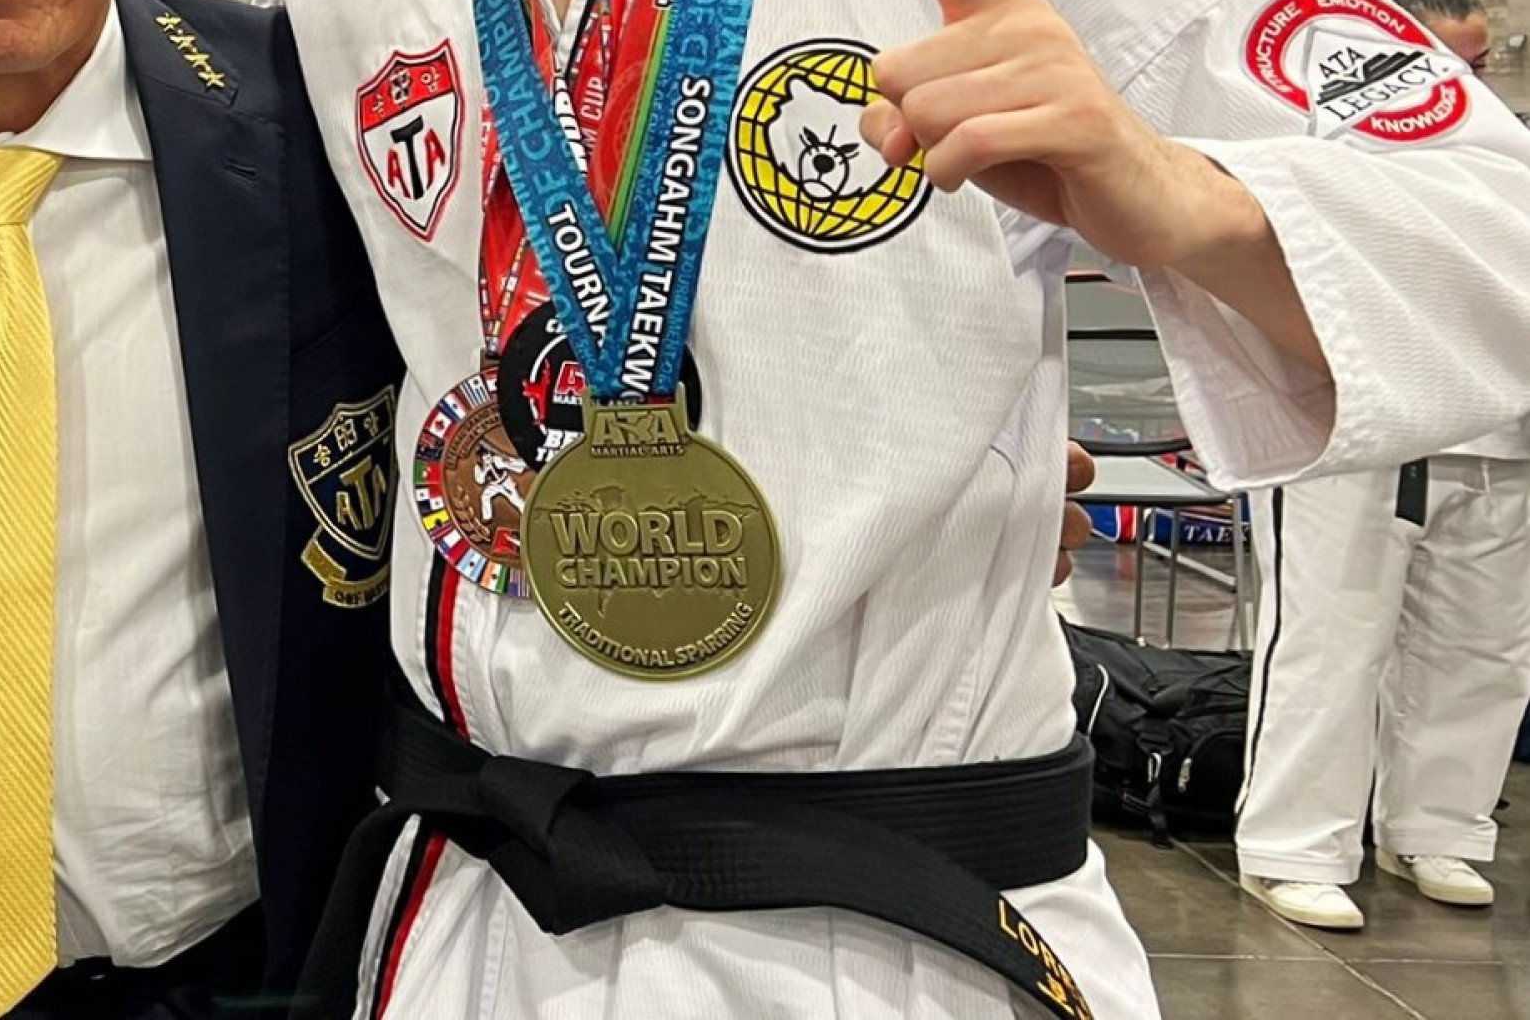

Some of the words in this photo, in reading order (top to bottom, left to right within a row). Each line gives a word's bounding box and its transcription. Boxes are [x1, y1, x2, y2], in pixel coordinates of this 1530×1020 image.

[1255, 0, 1303, 95] STRUCTURE
[1318, 46, 1367, 80] ATA
[581, 74, 606, 121] CUP
[1322, 56, 1441, 122] LEGACY
[386, 114, 446, 201] ATA
[647, 76, 713, 264] SONGAHM
[591, 409, 682, 446] ATA
[591, 445, 646, 458] MARTIAL
[650, 444, 685, 456] ARTS
[335, 455, 388, 532] ATA
[550, 510, 744, 556] WORLD
[555, 556, 748, 589] CHAMPION
[559, 600, 675, 668] TRADITIONAL
[675, 600, 755, 666] SPARRING
